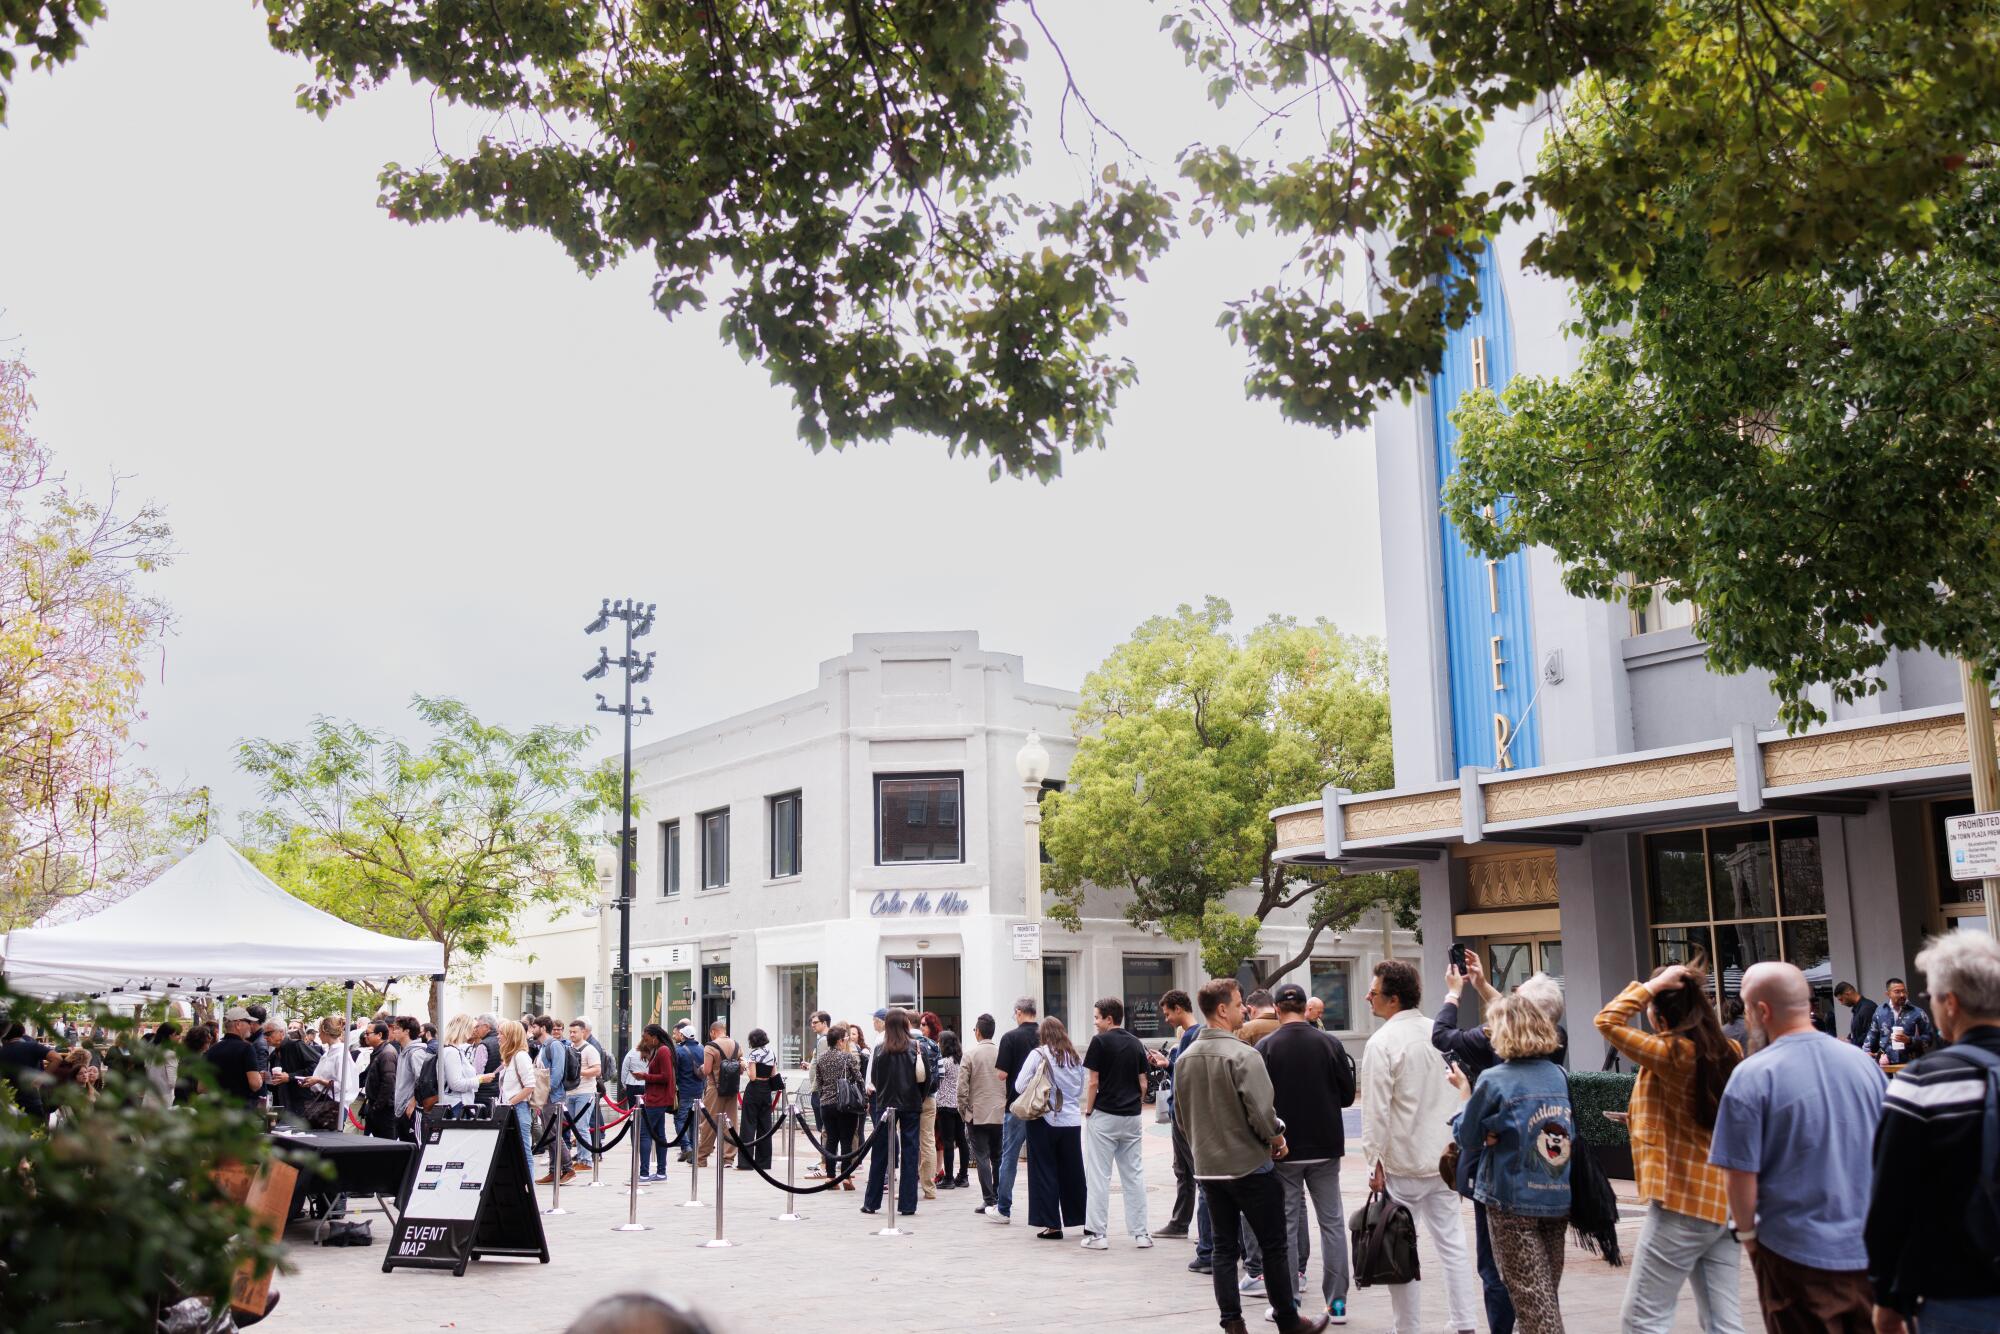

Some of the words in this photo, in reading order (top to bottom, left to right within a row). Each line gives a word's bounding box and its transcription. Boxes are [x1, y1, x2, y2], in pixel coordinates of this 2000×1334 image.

[1958, 817, 2000, 829] PROHIBITED
[1958, 832, 1971, 840] TOWN
[1972, 830, 1987, 839] PLAZA
[870, 890, 907, 915] Color
[910, 892, 931, 913] Me
[935, 892, 968, 915] Mine
[404, 1225, 447, 1240] EVENT
[399, 1242, 426, 1255] MAP
